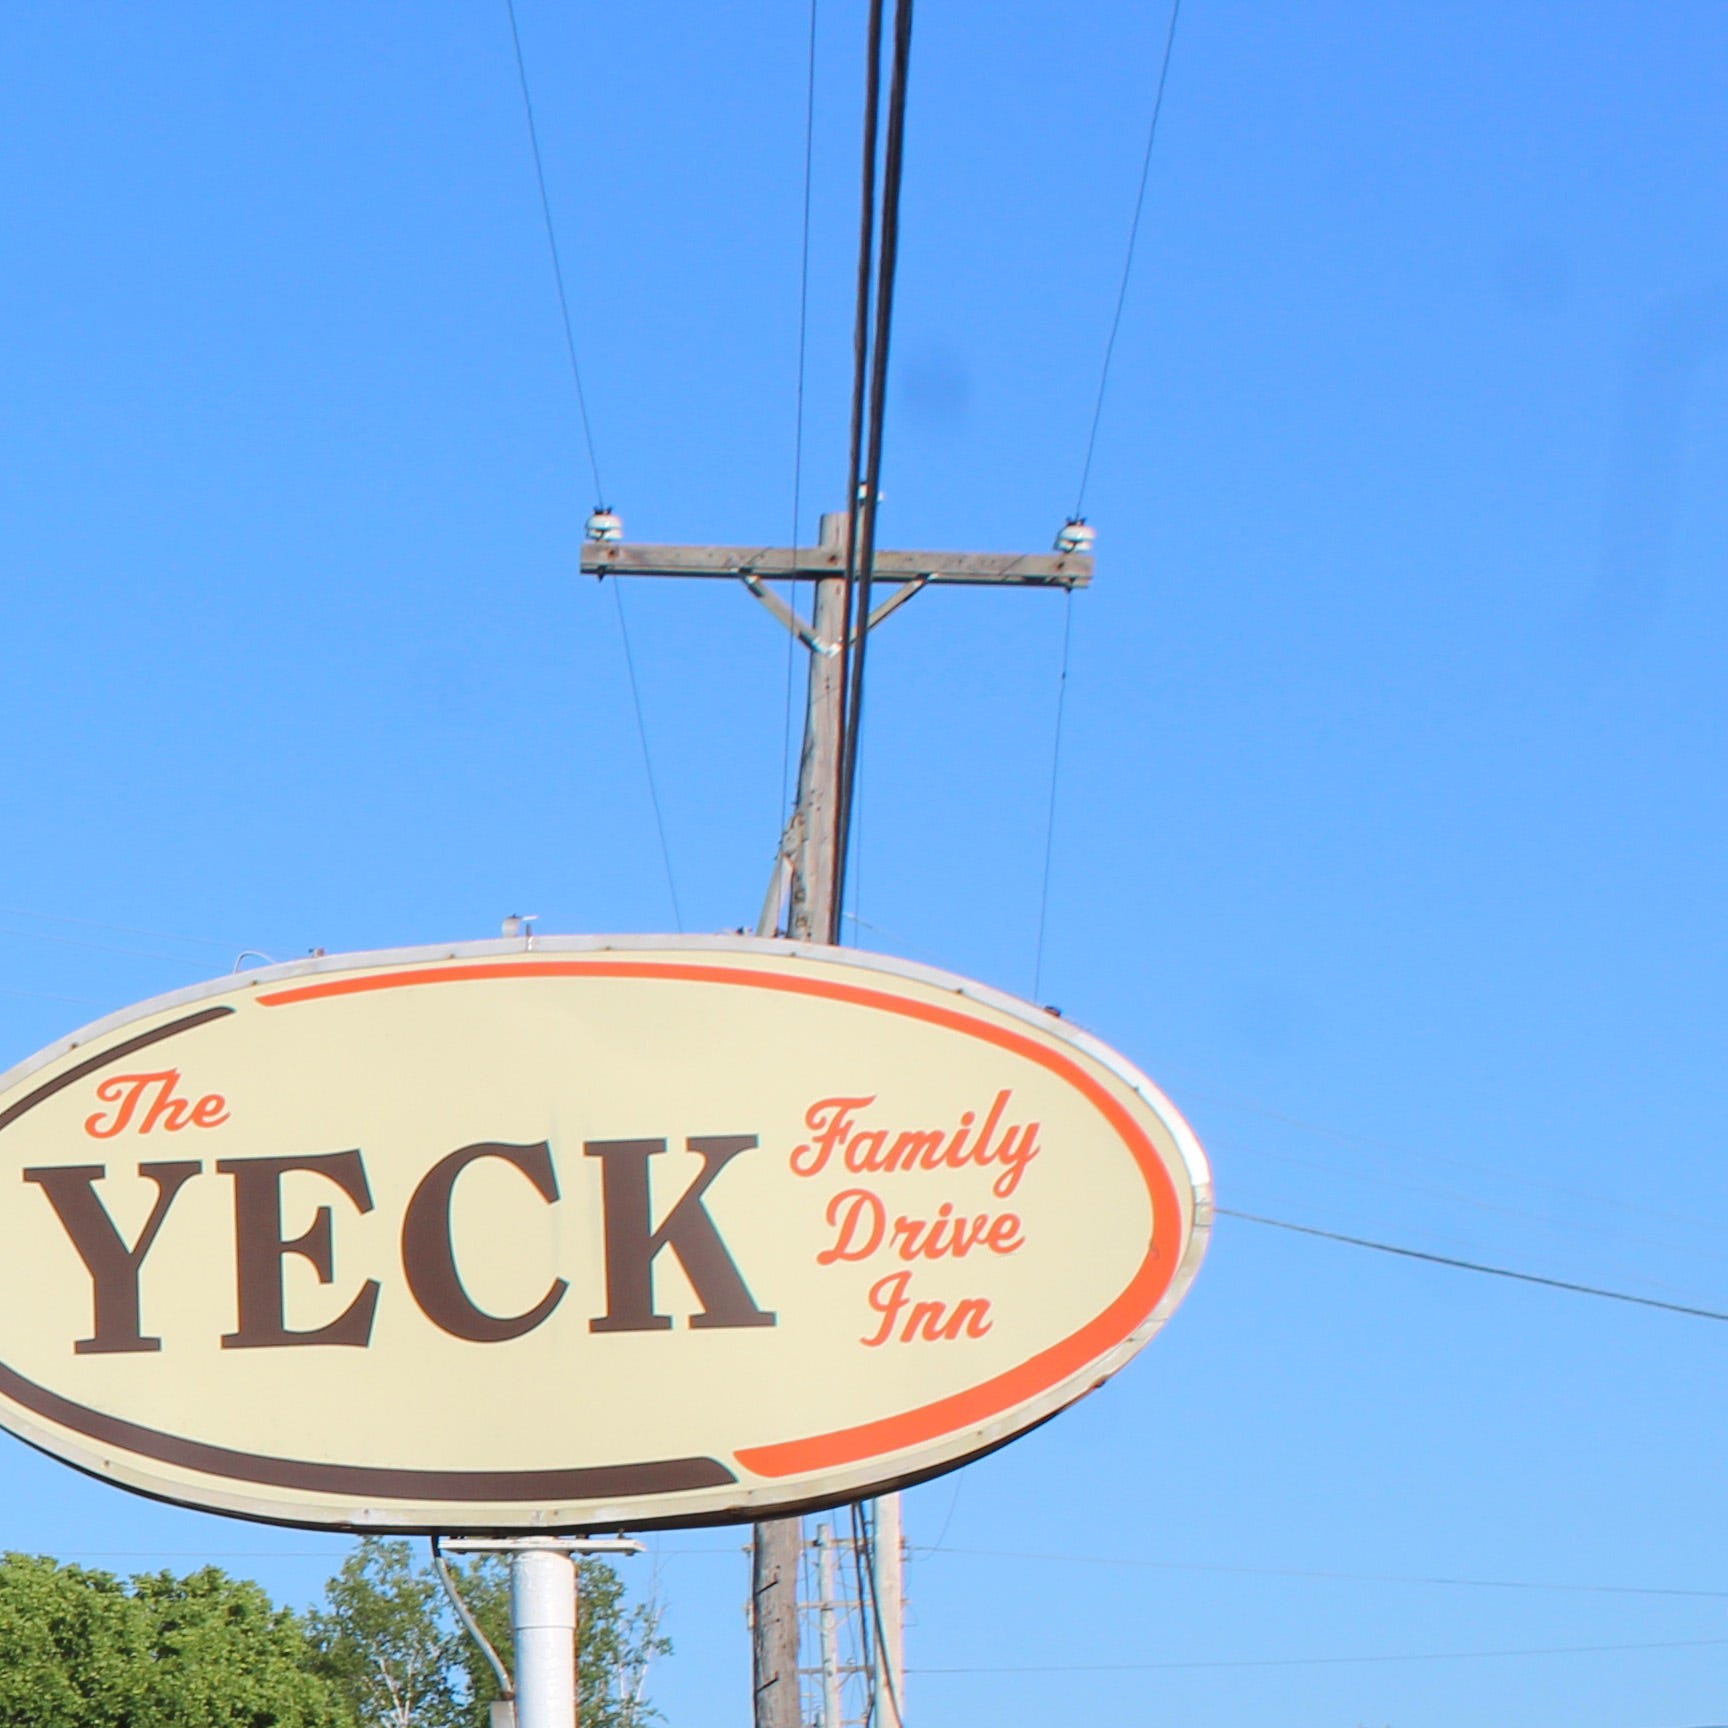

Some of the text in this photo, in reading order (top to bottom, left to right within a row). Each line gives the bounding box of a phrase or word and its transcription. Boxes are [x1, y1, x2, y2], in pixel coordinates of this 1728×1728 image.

[84, 1067, 231, 1139] The
[789, 1088, 1040, 1198] Family
[22, 1134, 777, 1354] YECK
[816, 1188, 1025, 1265] Drive
[859, 1270, 993, 1347] Inn
